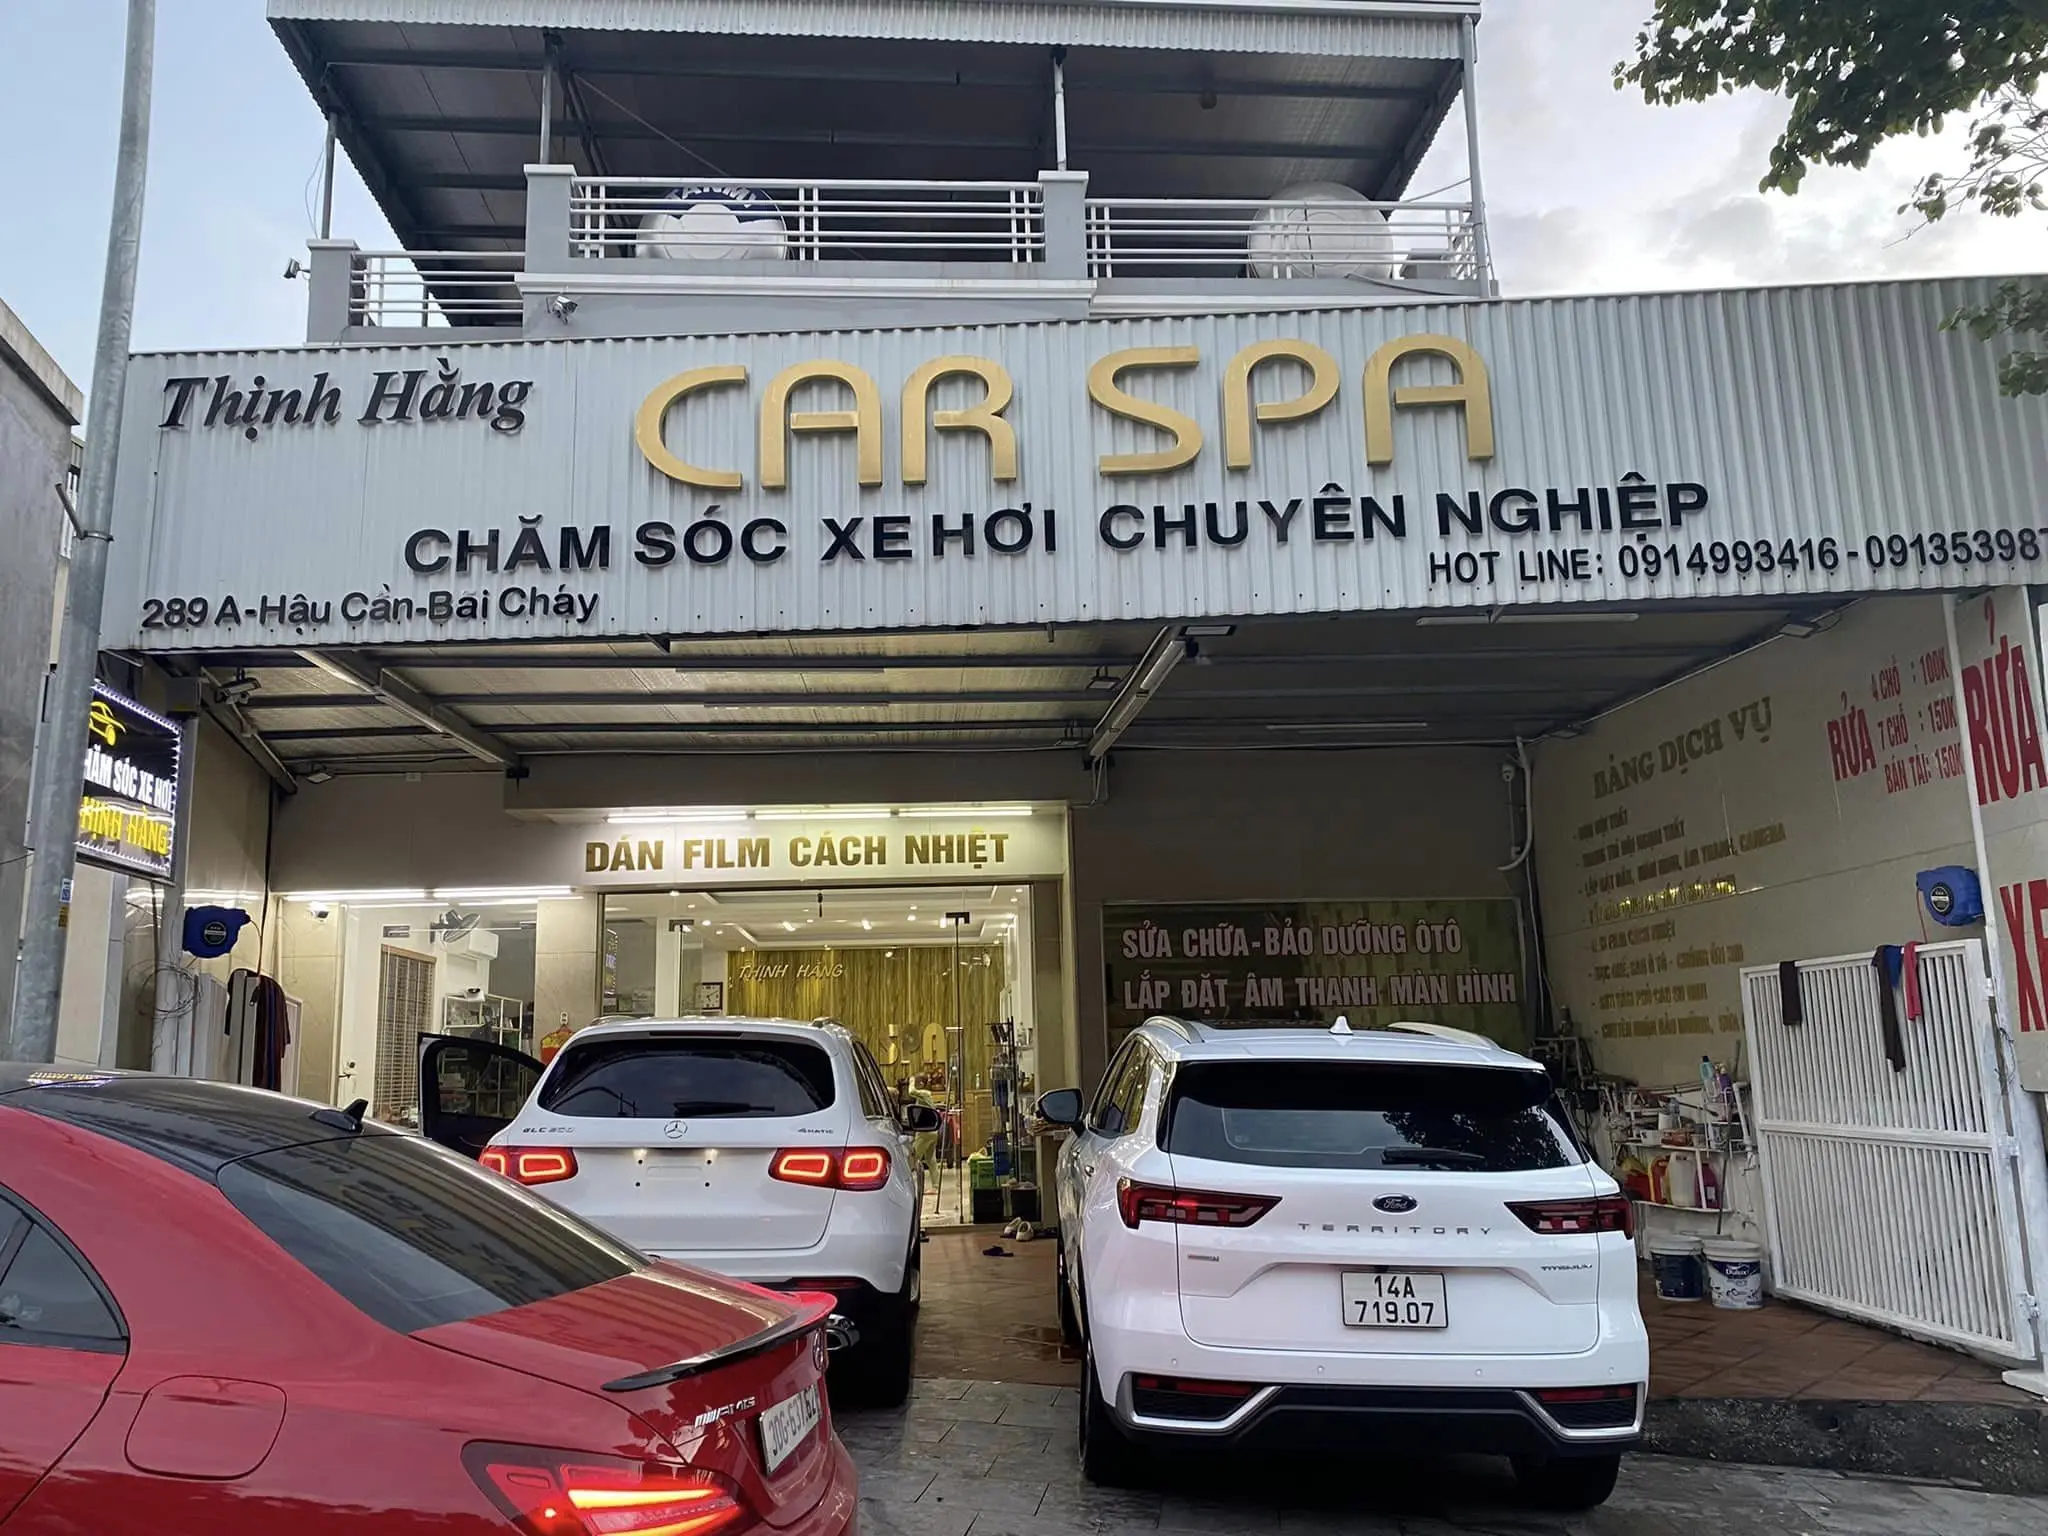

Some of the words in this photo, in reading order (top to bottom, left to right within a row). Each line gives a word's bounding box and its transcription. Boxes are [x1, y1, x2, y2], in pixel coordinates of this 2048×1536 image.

[159, 372, 342, 440] Thịnh
[358, 357, 534, 432] Hằng
[635, 354, 1018, 490] CAR
[1088, 333, 1494, 476] SPA
[404, 514, 611, 573] CHĂM
[634, 505, 788, 565] SÓC
[821, 515, 913, 561] XE
[933, 503, 1056, 557] HƠI
[1099, 482, 1407, 550] CHUYÊN
[1435, 471, 1709, 541] NGHIỆP
[1429, 550, 1501, 585] HOT
[1518, 548, 1603, 583] LINE:
[499, 583, 599, 624] Cháy
[1920, 646, 1950, 686] 100K
[1928, 696, 1957, 734] 150K
[1961, 595, 2048, 806] RỬA
[1658, 718, 1724, 775] DỊCH
[1727, 696, 1772, 743] VỤ
[1827, 690, 1877, 782] RỬA
[585, 833, 664, 873] DÁN
[683, 838, 771, 870] FILM
[788, 829, 887, 867] CÁCH
[904, 825, 1009, 870] NHIỆT
[1122, 919, 1173, 958] SỬA
[1321, 918, 1407, 955] DƯỠNG
[1415, 917, 1462, 954] ÔTÔ
[1124, 969, 1171, 1010] LẮP
[1181, 972, 1229, 1016] ĐẶT
[1244, 971, 1284, 1008] ÂM
[1295, 974, 1377, 1007] THANH
[1389, 968, 1449, 1005] MÀN
[1455, 967, 1516, 1004] HÌNH
[1297, 1222, 1492, 1236] TERRITORY
[1374, 1275, 1416, 1298] 14A
[1354, 1301, 1434, 1324] 719.07
